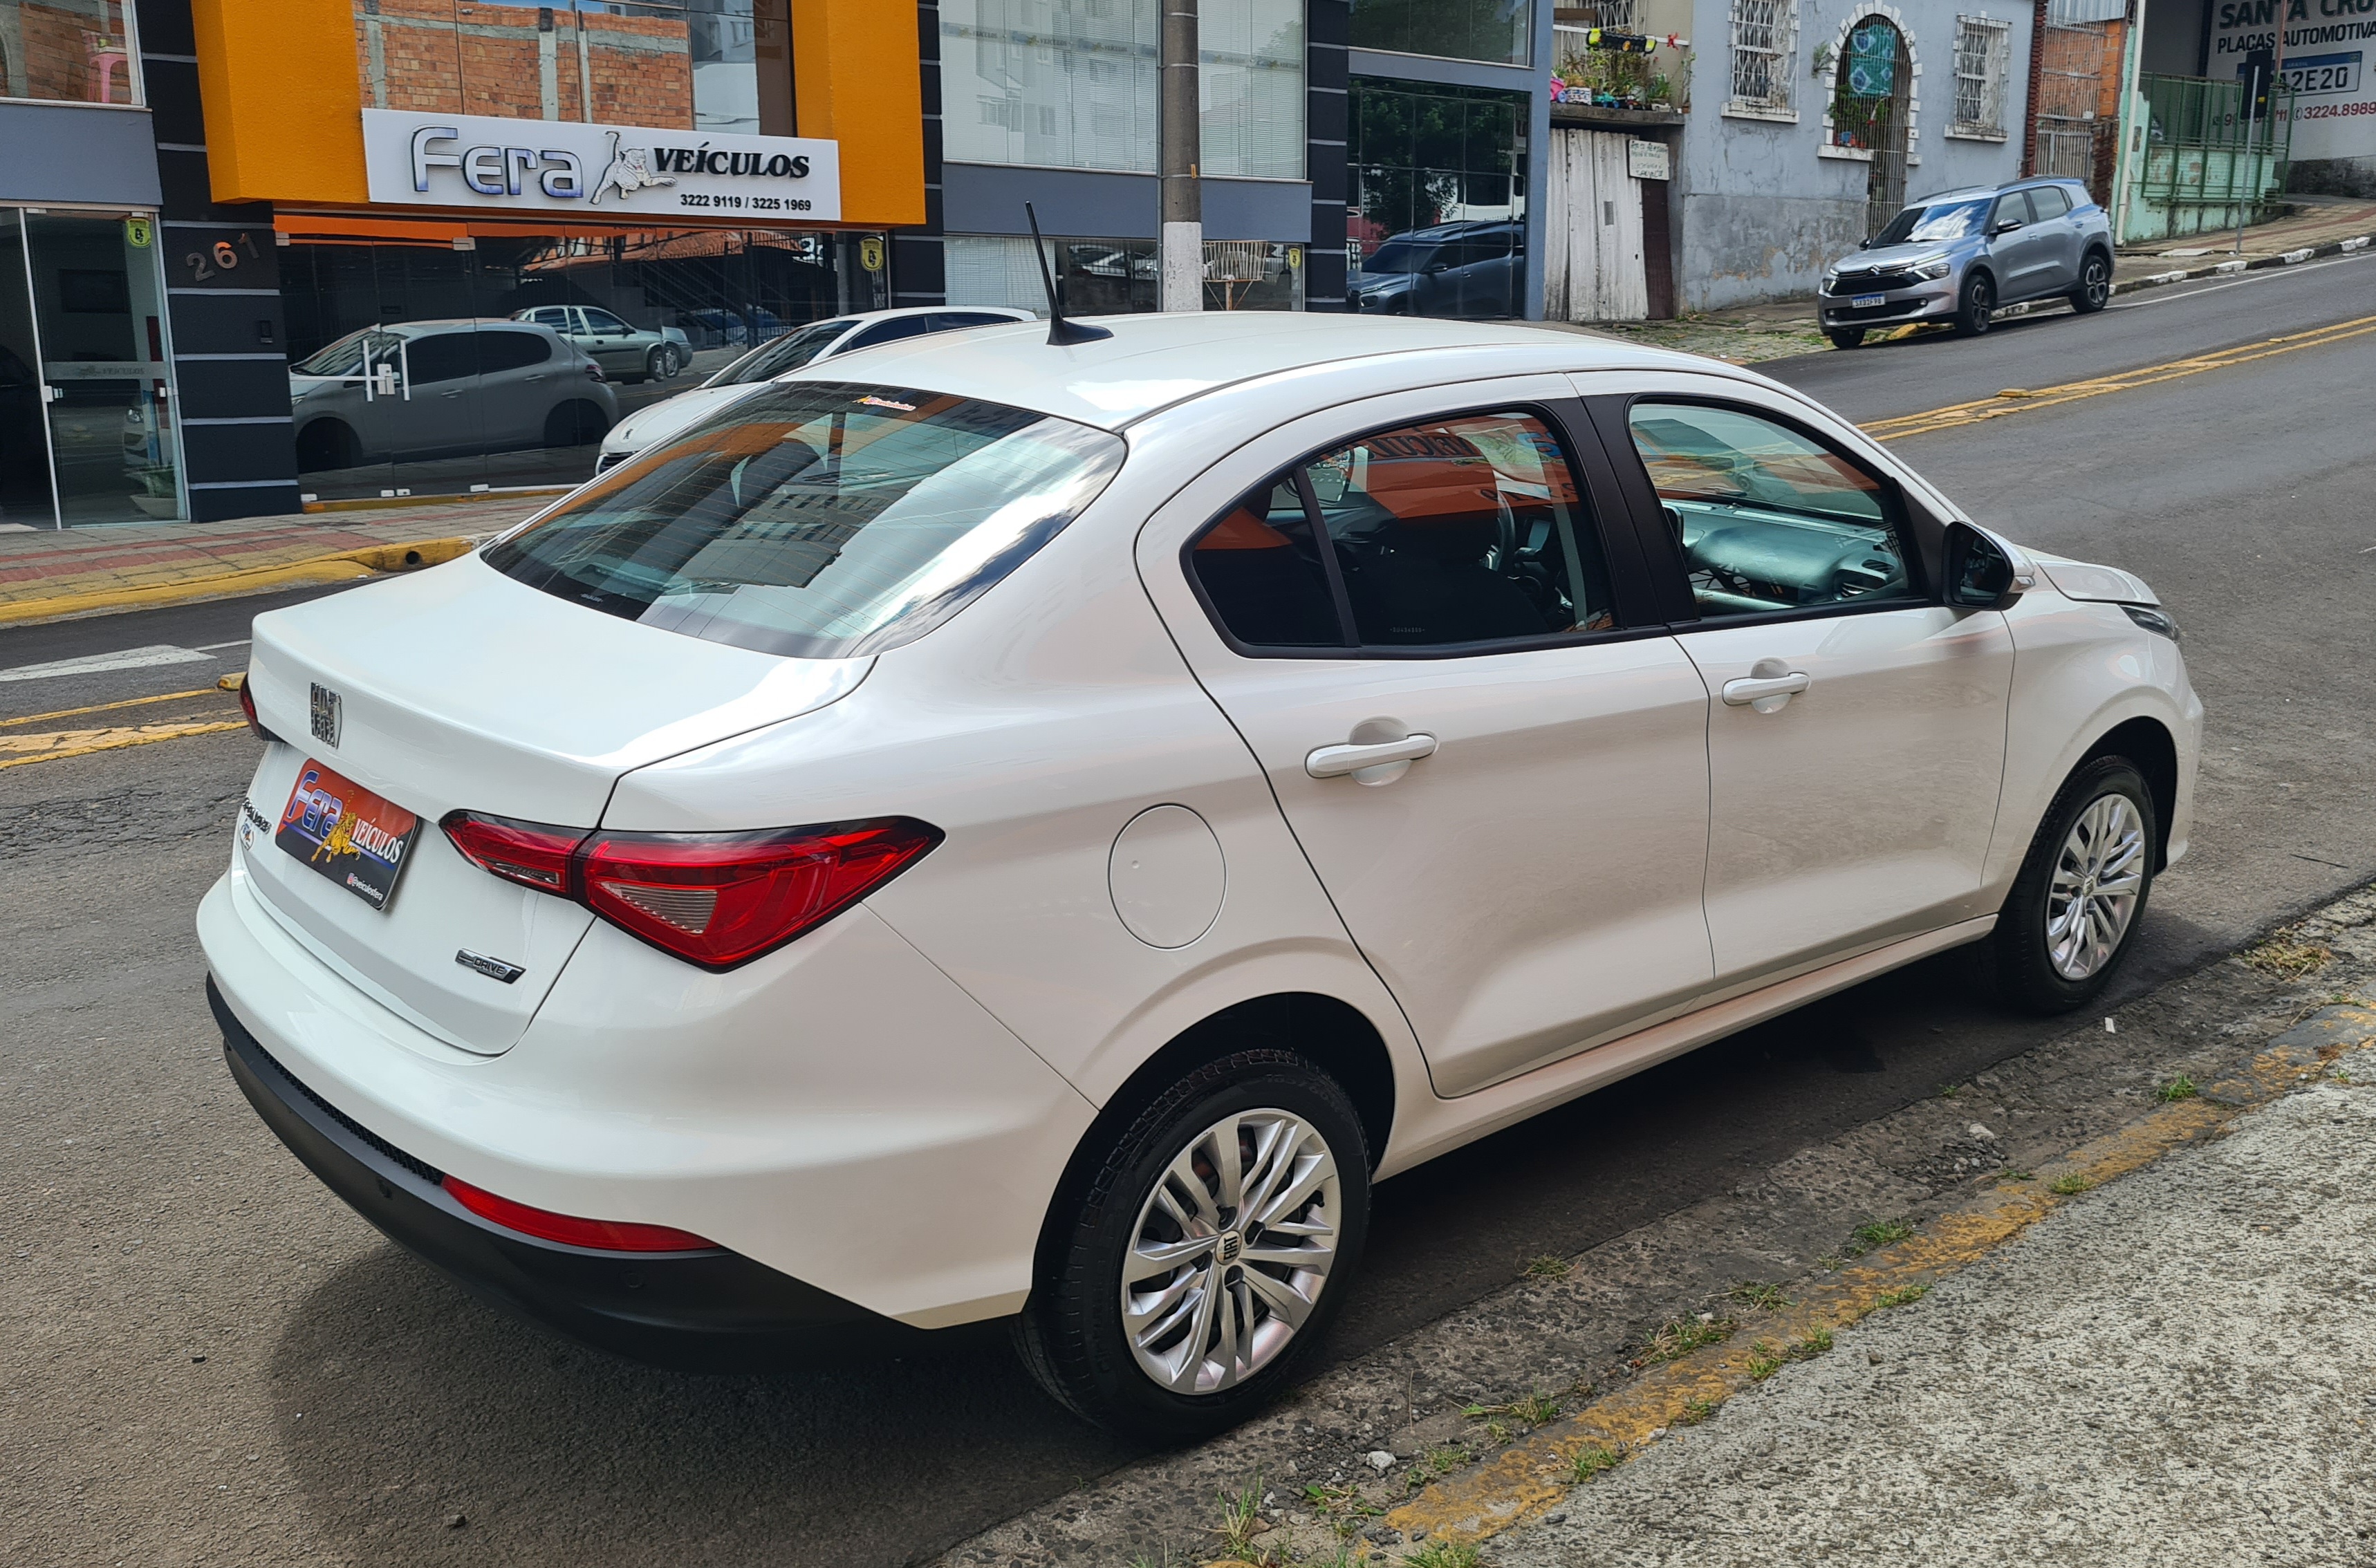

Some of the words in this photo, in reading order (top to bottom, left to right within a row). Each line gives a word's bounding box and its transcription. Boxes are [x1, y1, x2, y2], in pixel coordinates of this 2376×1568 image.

[2218, 0, 2309, 29] SANA
[2218, 32, 2275, 54] PLACAS
[2303, 102, 2376, 119] 3224.8989
[654, 141, 810, 178] VEÍCULOS
[680, 194, 709, 207] 3222
[713, 196, 741, 208] 9119
[745, 196, 750, 208] /
[752, 197, 781, 210] 3225
[783, 198, 812, 211] 1969
[186, 232, 259, 281] 261
[351, 817, 405, 864] VEÍCULOS
[473, 957, 508, 976] DRIVE
[1223, 1235, 1238, 1261] FIAT
